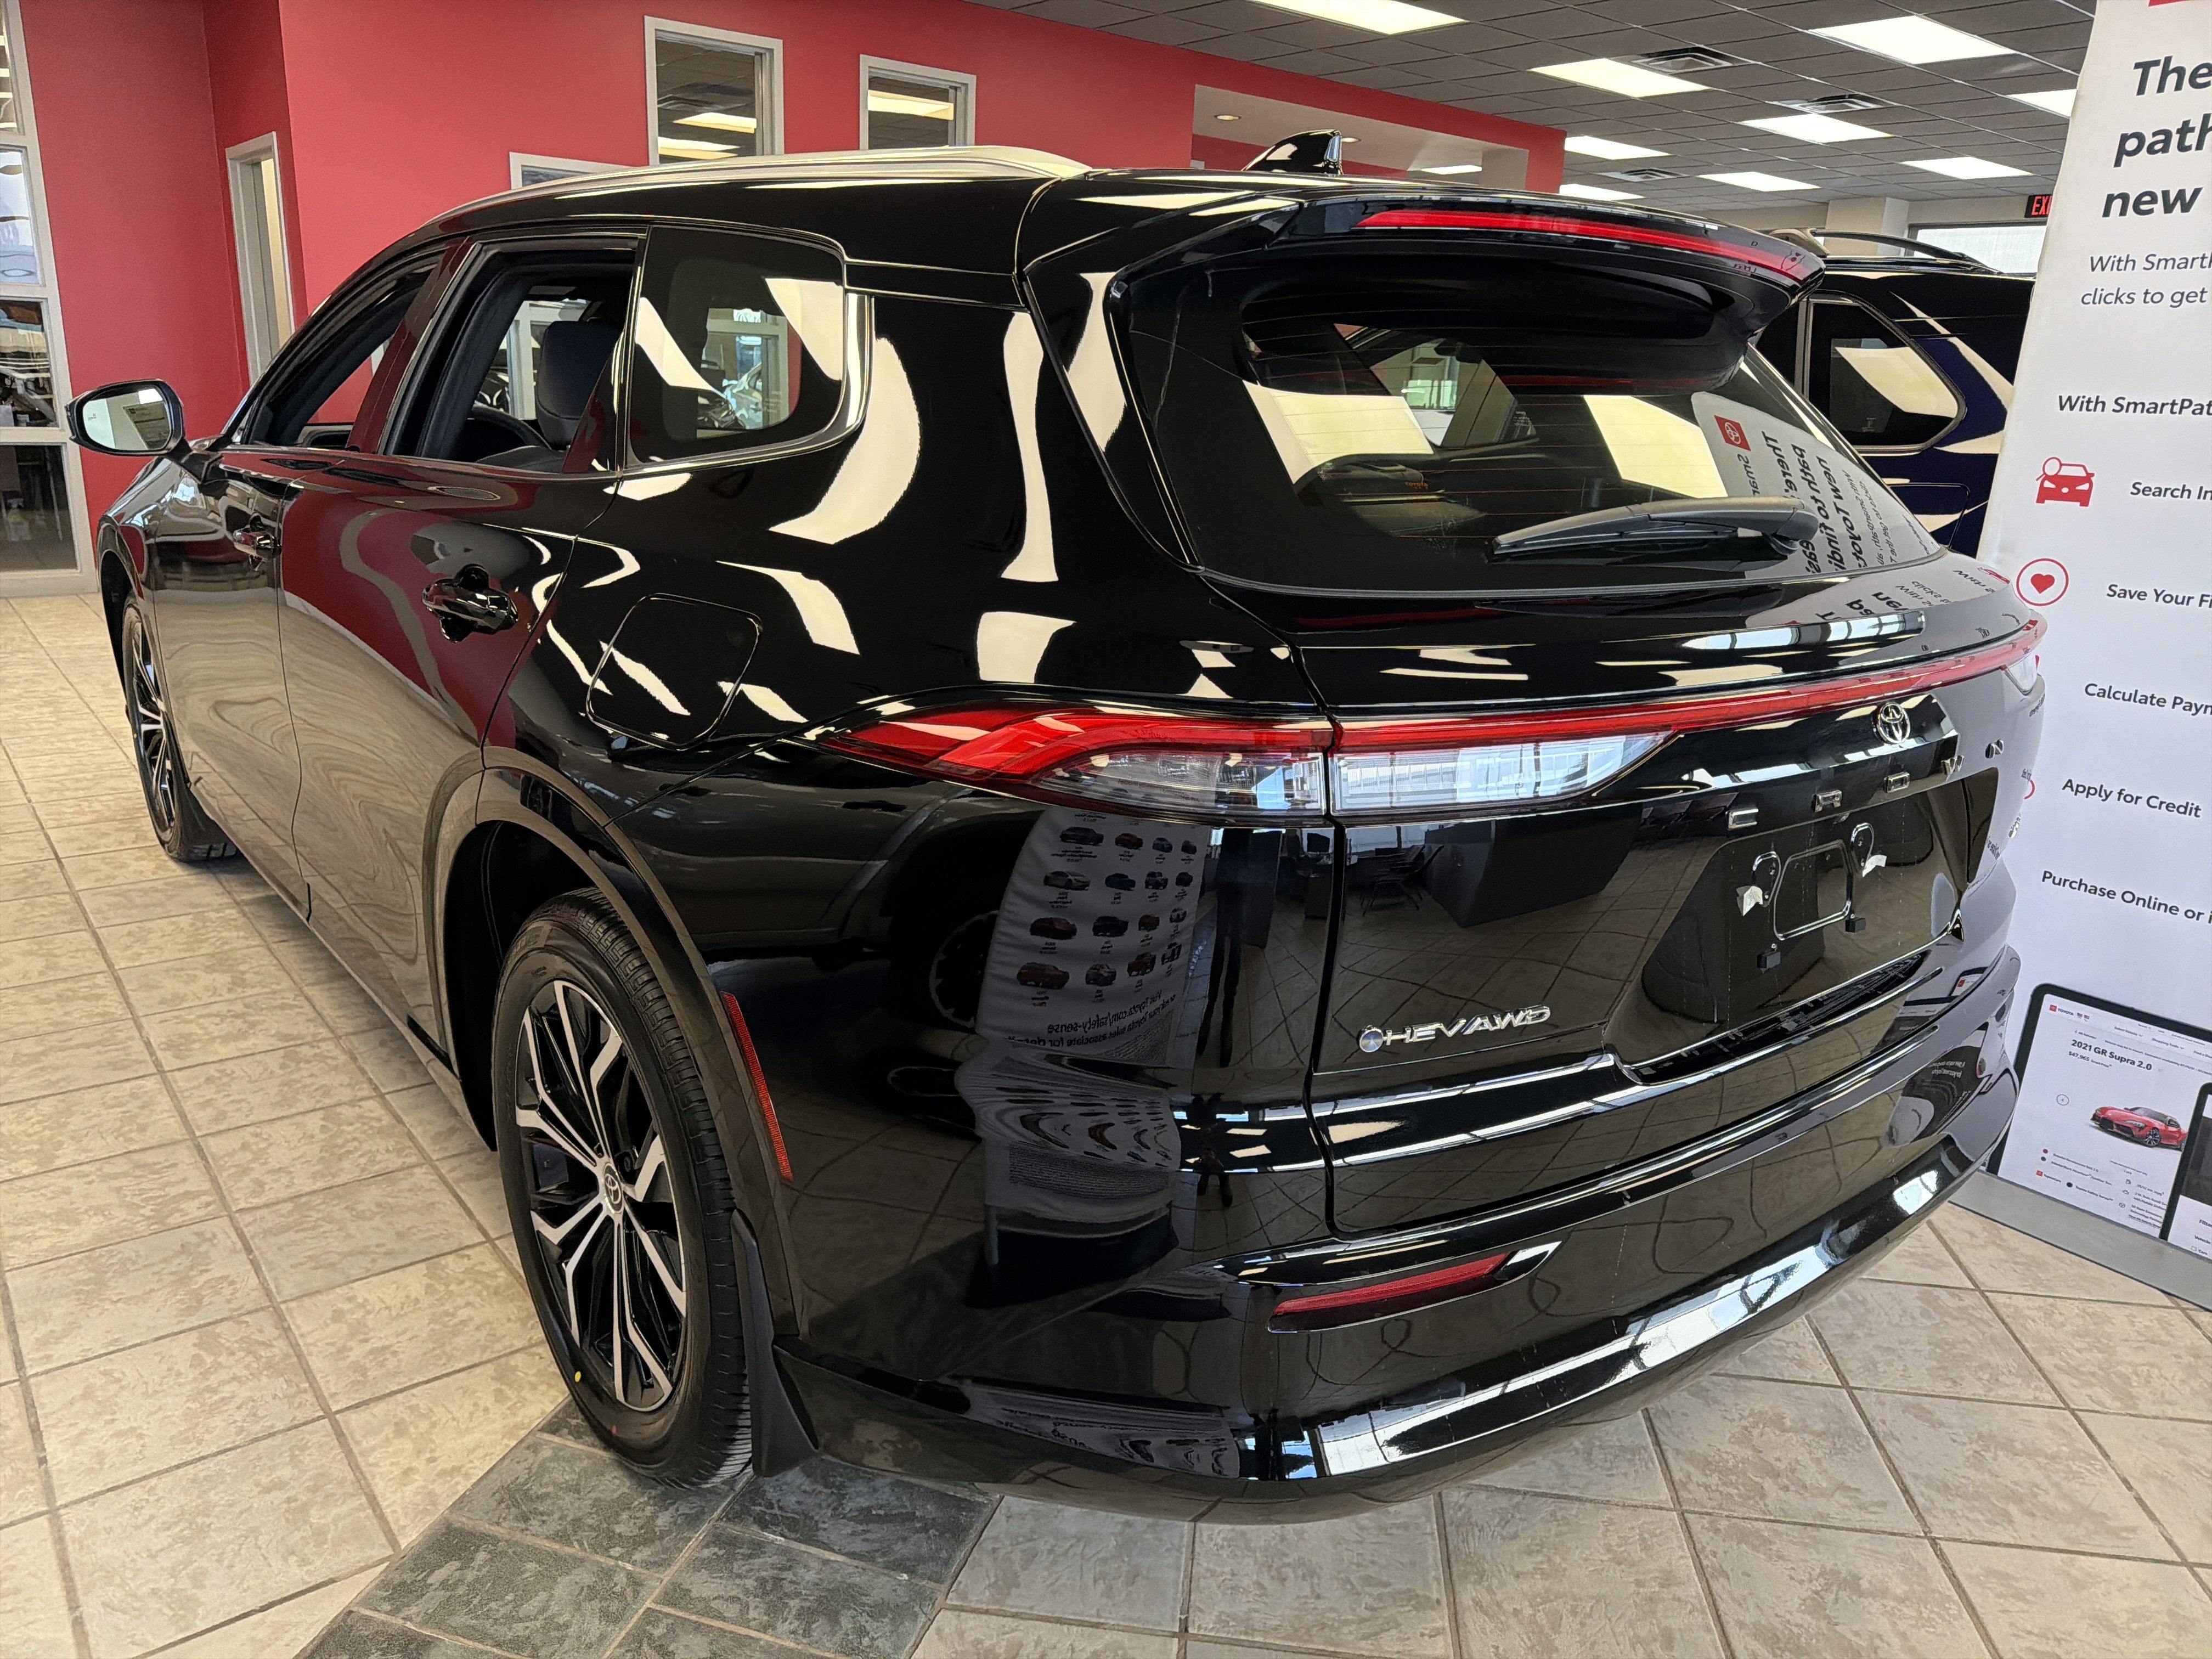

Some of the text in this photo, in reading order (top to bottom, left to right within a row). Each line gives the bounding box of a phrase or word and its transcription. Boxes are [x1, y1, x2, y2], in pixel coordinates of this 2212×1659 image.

[2032, 195, 2053, 216] EXI
[2102, 185, 2203, 218] new
[2090, 252, 2212, 272] With Smart
[2081, 287, 2208, 308] clicks to get
[2058, 394, 2106, 413] With
[2130, 481, 2192, 500] Search
[2106, 584, 2148, 601] Save
[2153, 588, 2195, 607] Your
[2084, 683, 2167, 708] Calculate
[2061, 778, 2202, 819] Apply for Credit
[2041, 870, 2117, 900] Purchase
[2120, 889, 2180, 916] Online
[2183, 907, 2205, 923] or
[2068, 1051, 2090, 1062] $47,965
[2071, 1039, 2152, 1070] 2021 GR Supra 2.0
